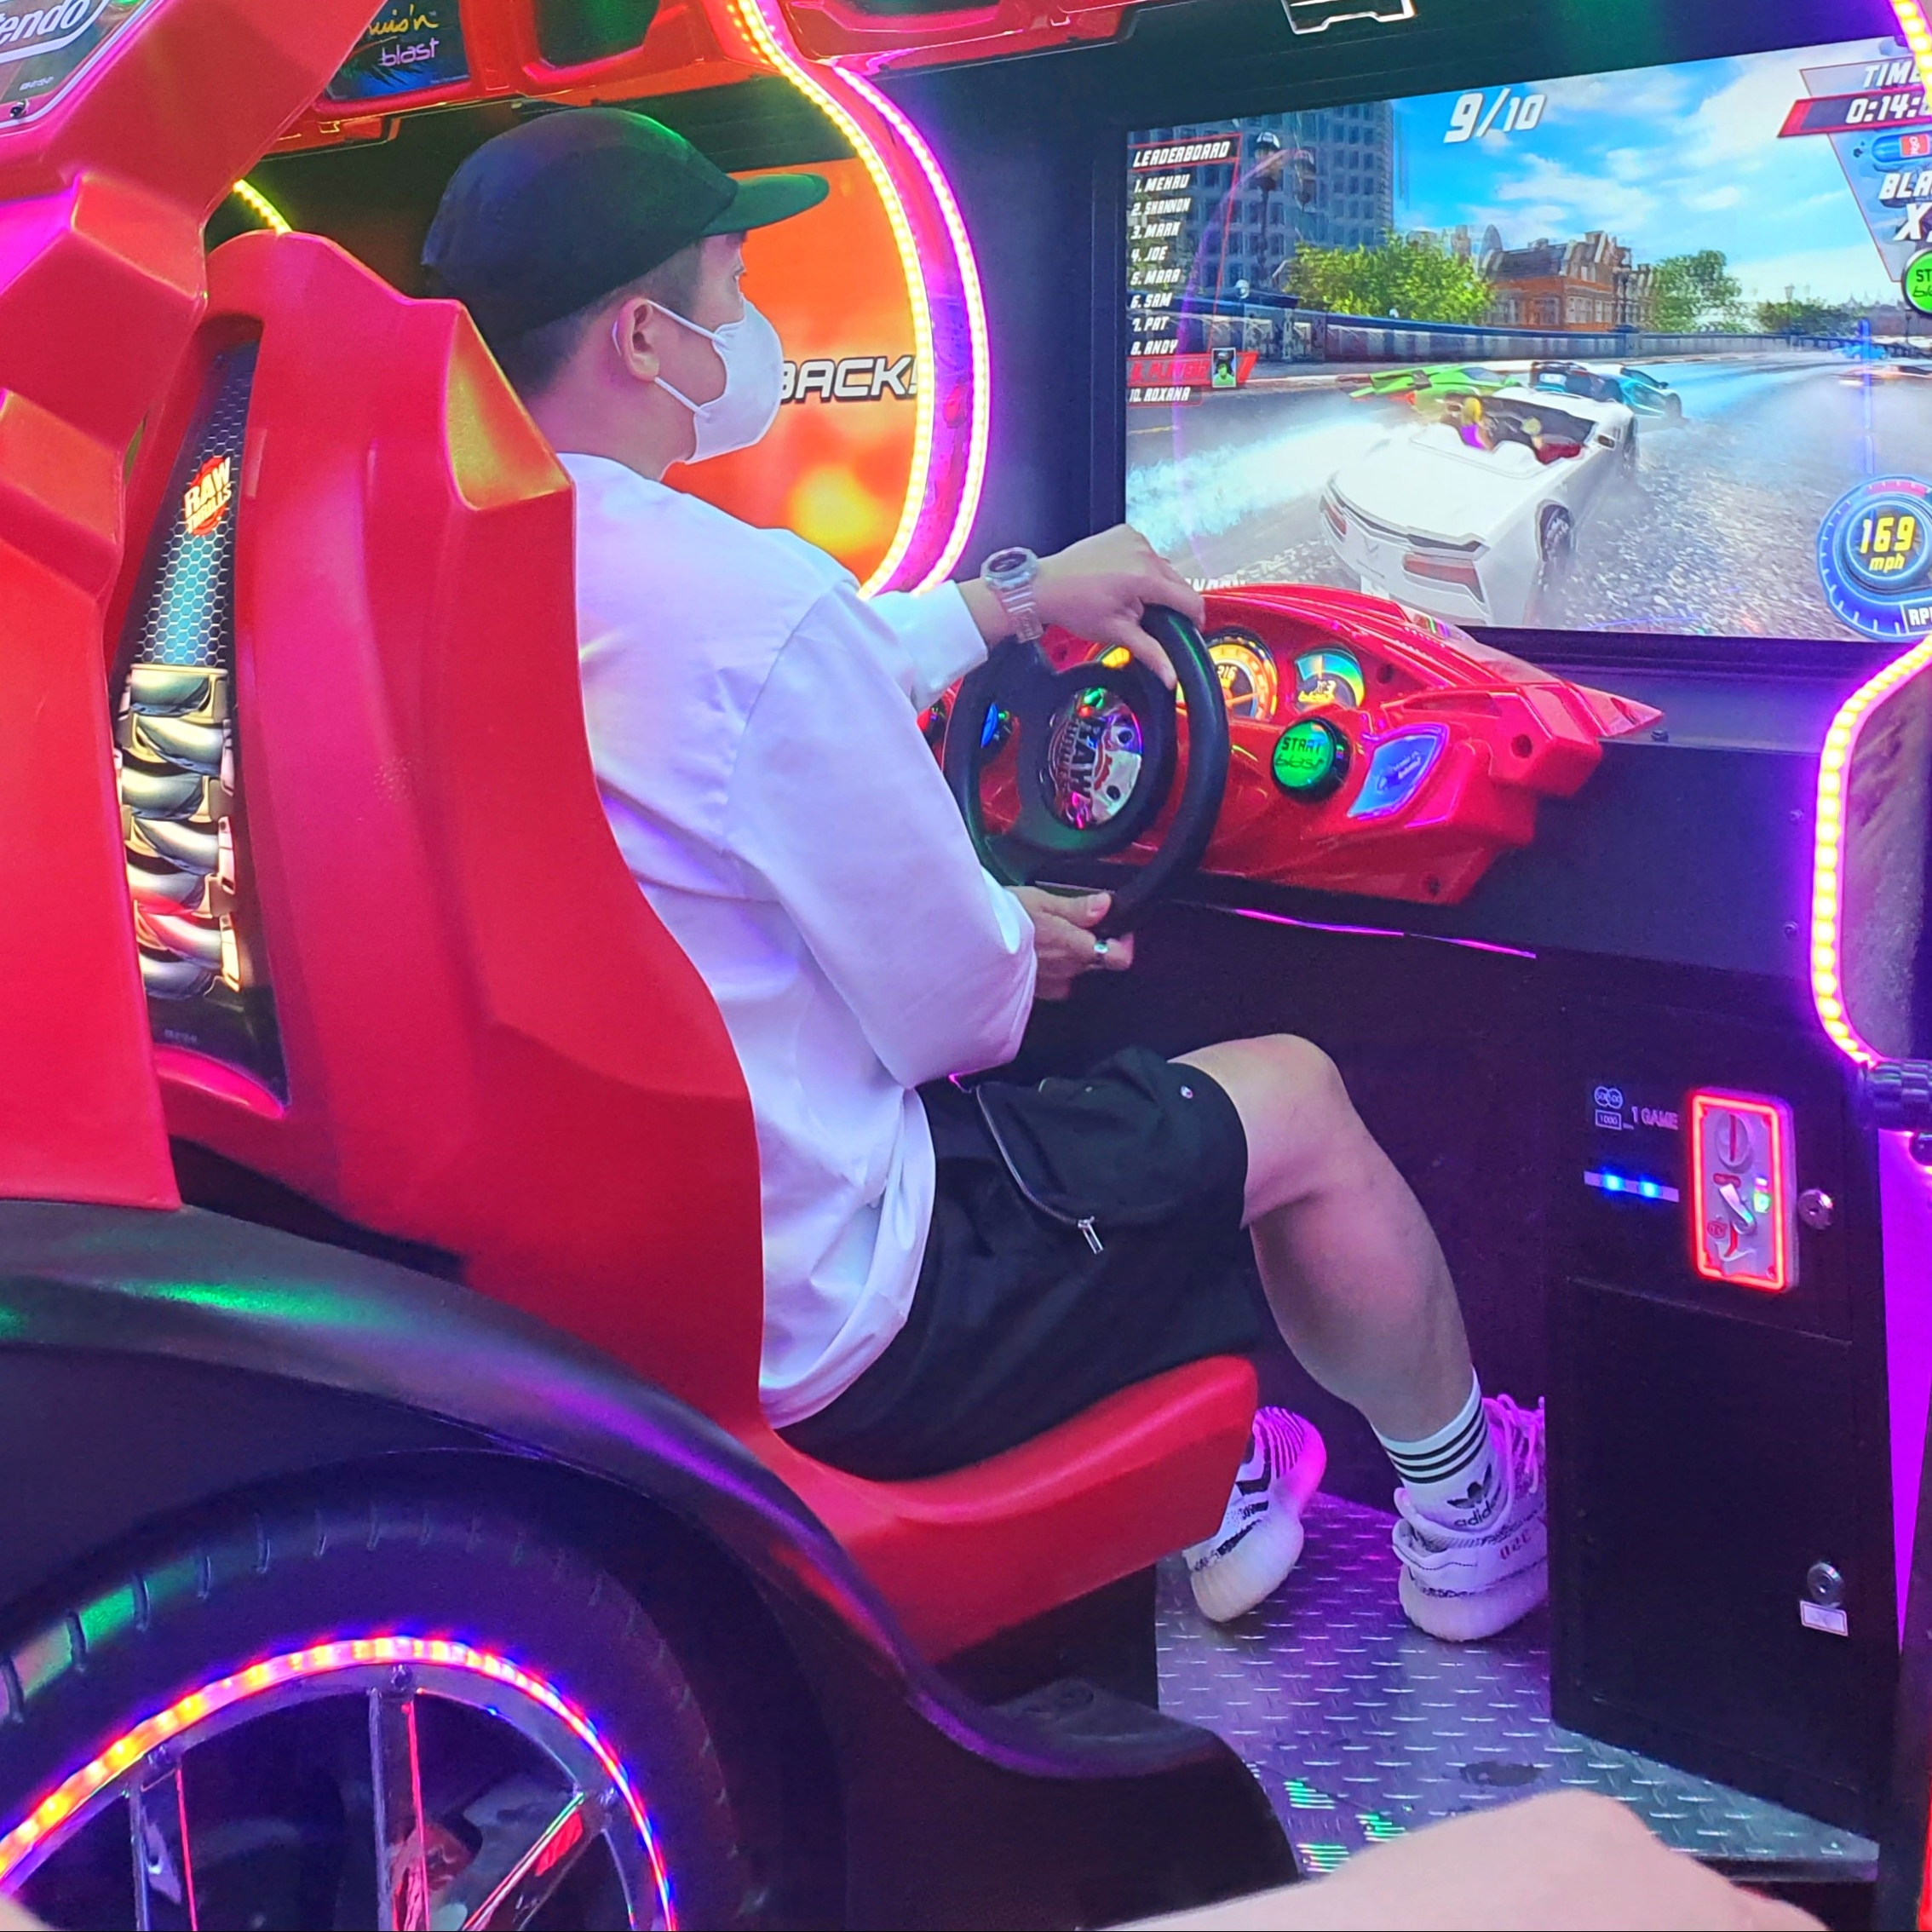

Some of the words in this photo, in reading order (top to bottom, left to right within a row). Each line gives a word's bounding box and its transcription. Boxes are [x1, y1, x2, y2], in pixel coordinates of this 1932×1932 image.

[377, 37, 440, 67] blast
[1443, 87, 1546, 144] 9/10
[1132, 141, 1231, 168] LEADERBOARD
[1877, 170, 1932, 200] BLA
[1130, 202, 1142, 217] 2.
[1144, 197, 1191, 216] SHANNON
[1130, 224, 1142, 240] 3.
[1143, 221, 1182, 239] MARK
[1892, 201, 1932, 243] X
[1142, 245, 1169, 262] JOE
[1130, 271, 1142, 286] 5.
[1130, 294, 1142, 309] 6.
[1143, 291, 1173, 308] SAM
[1143, 315, 1170, 331] PAT
[1143, 338, 1179, 355] ANDY
[1143, 386, 1191, 402] ROXANA
[184, 456, 231, 520] RAW
[186, 482, 232, 534] THRILLS
[1859, 515, 1916, 555] 169
[1868, 552, 1906, 574] mph
[1907, 606, 1932, 626] RP
[1281, 735, 1324, 755] START
[1641, 1107, 1678, 1130] GAME
[1453, 1497, 1495, 1527] adid
